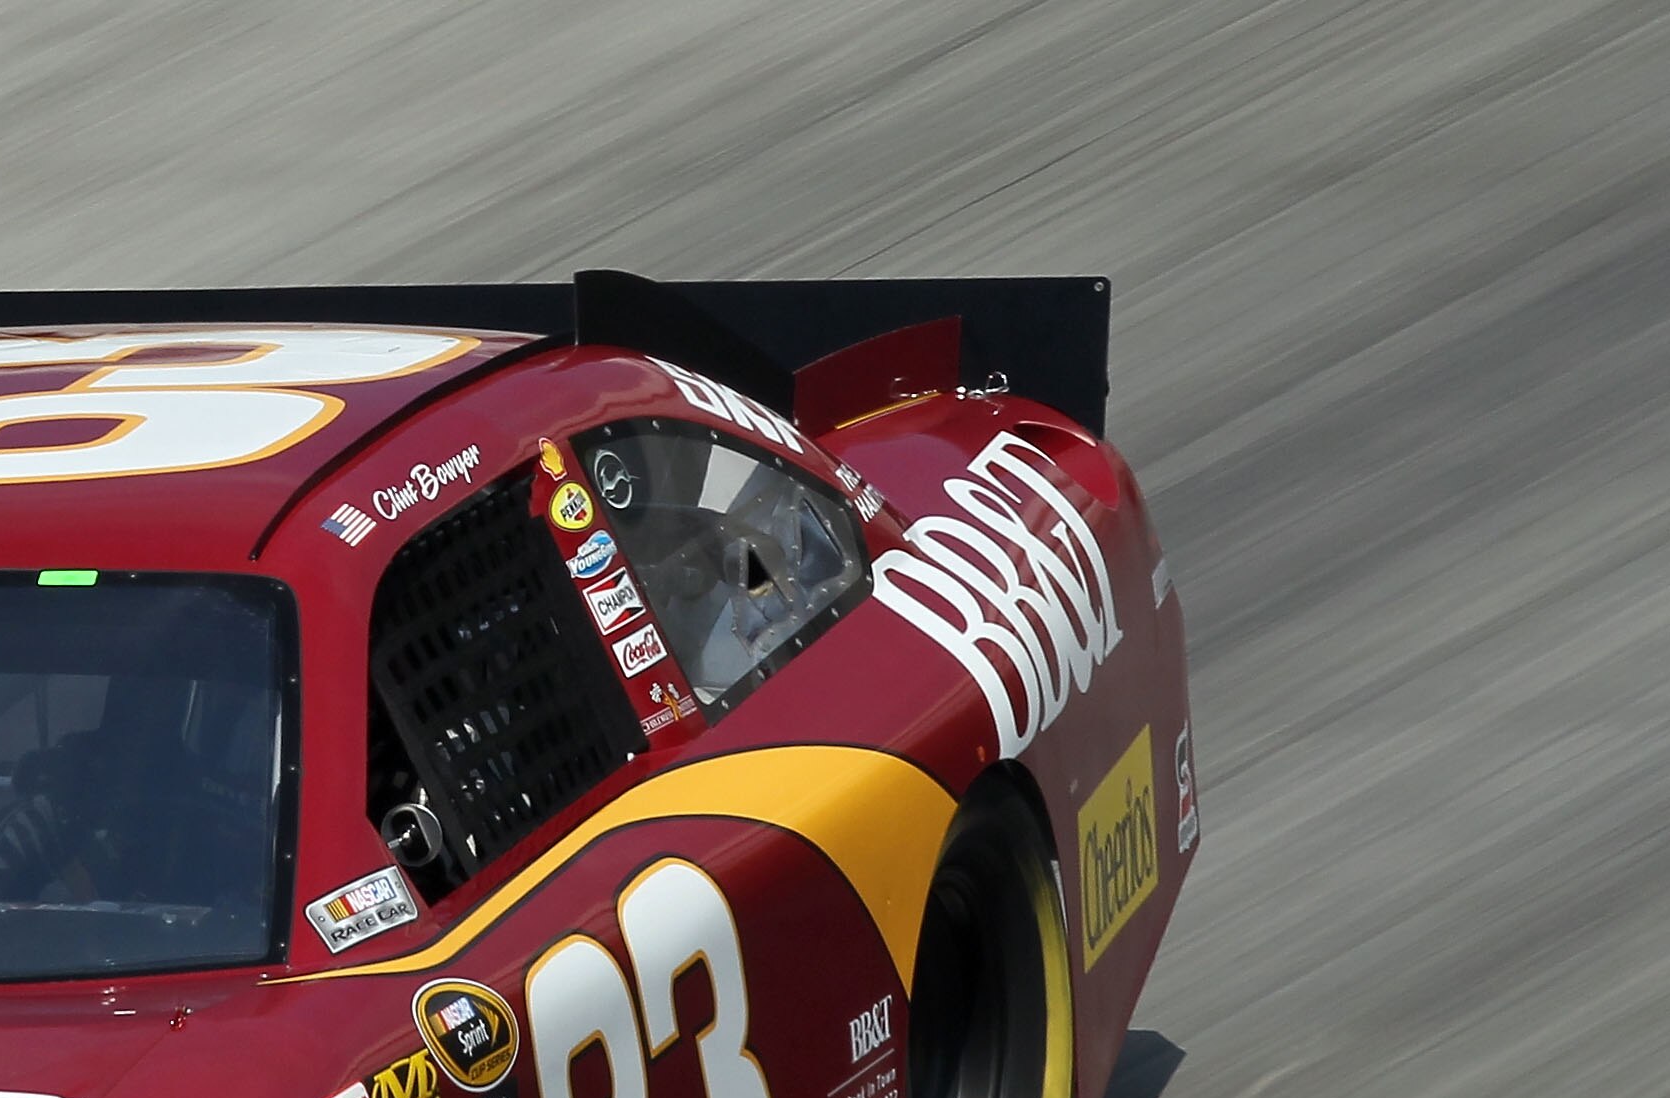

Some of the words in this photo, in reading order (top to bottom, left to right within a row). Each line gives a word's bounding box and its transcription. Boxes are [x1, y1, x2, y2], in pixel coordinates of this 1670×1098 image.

[373, 480, 418, 520] Clint
[410, 444, 479, 500] Bowyer
[871, 431, 1123, 760] BB&T
[345, 877, 395, 914] NASCAR
[1084, 777, 1153, 950] Cheerios
[331, 918, 378, 942] RACE
[377, 903, 409, 921] CAR
[458, 1019, 490, 1057] Sprint
[849, 994, 892, 1064] BB&T
